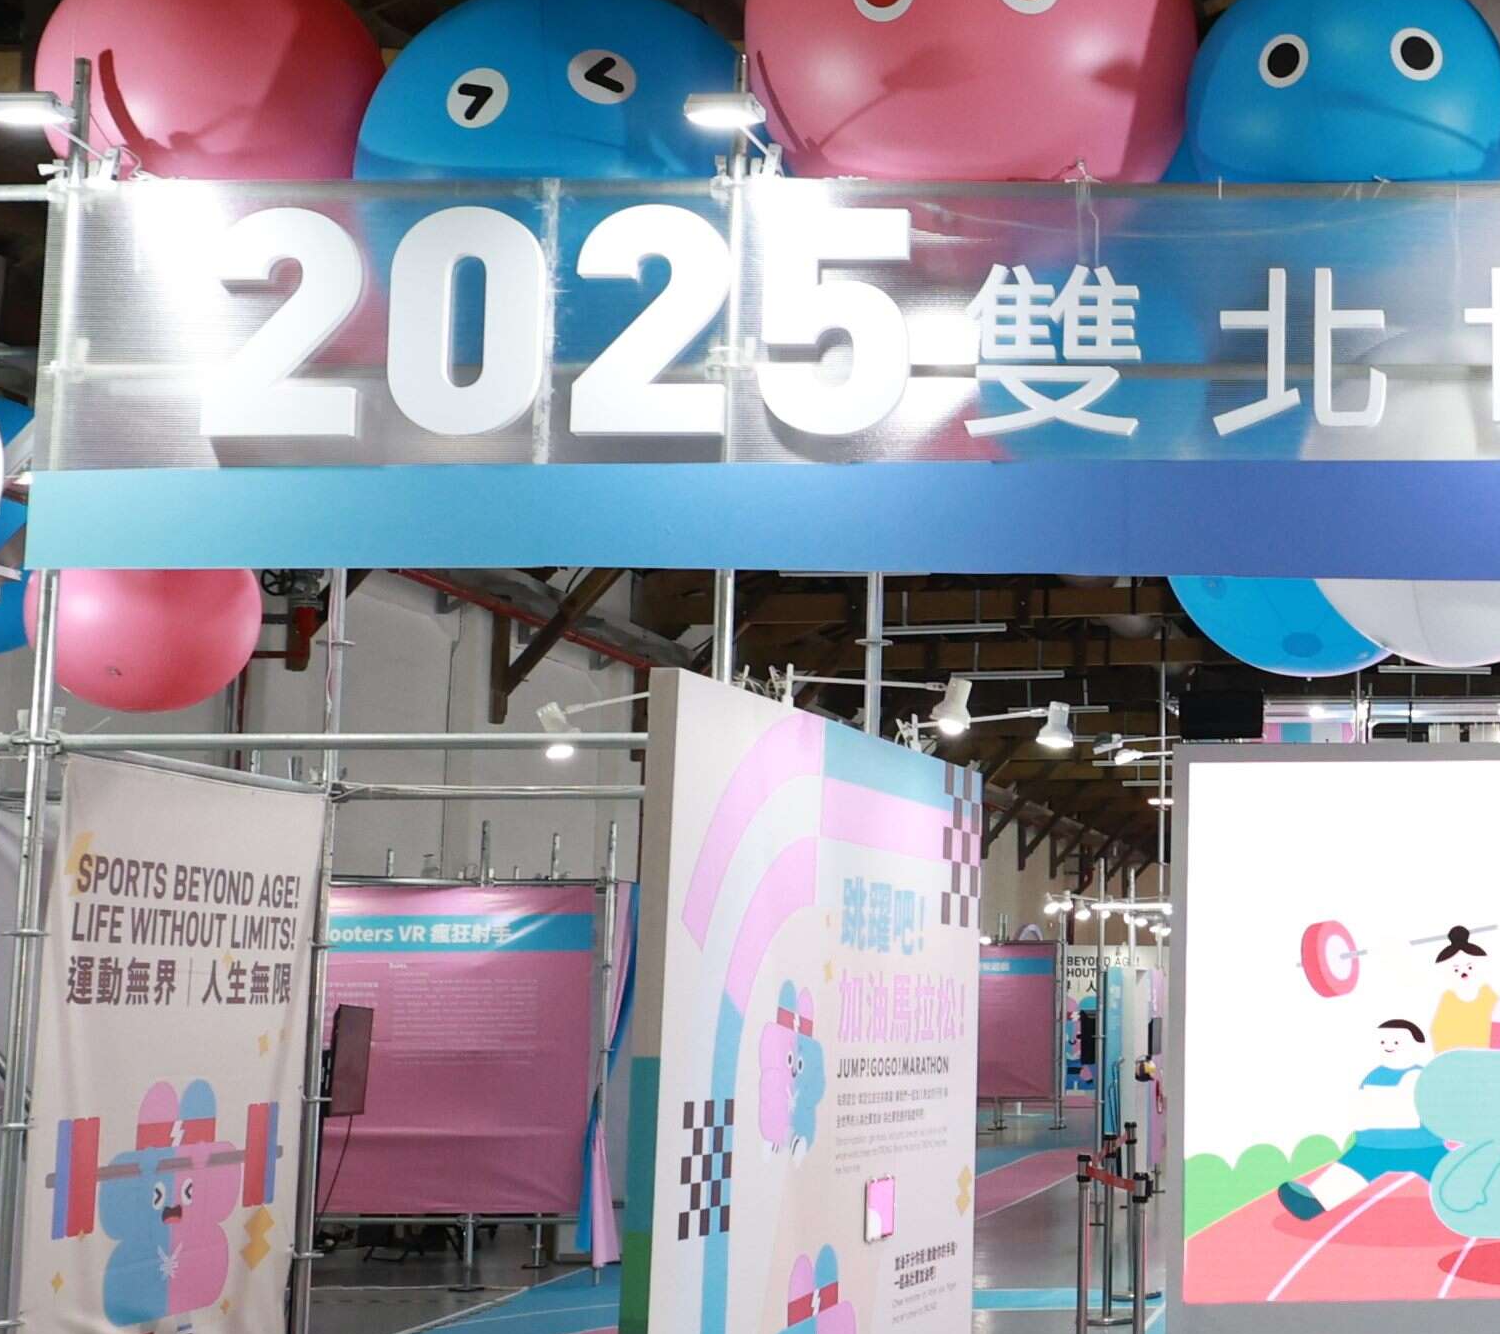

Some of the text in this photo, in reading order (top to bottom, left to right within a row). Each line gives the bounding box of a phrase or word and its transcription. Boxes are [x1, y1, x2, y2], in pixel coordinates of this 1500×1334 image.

[77, 854, 301, 909] SPORTS BEYOND AGE!
[71, 901, 297, 952] LIFE WITHOUT LIMITS!
[326, 926, 394, 943] ooters
[399, 926, 424, 941] VR
[1067, 956, 1110, 966] BEYOD
